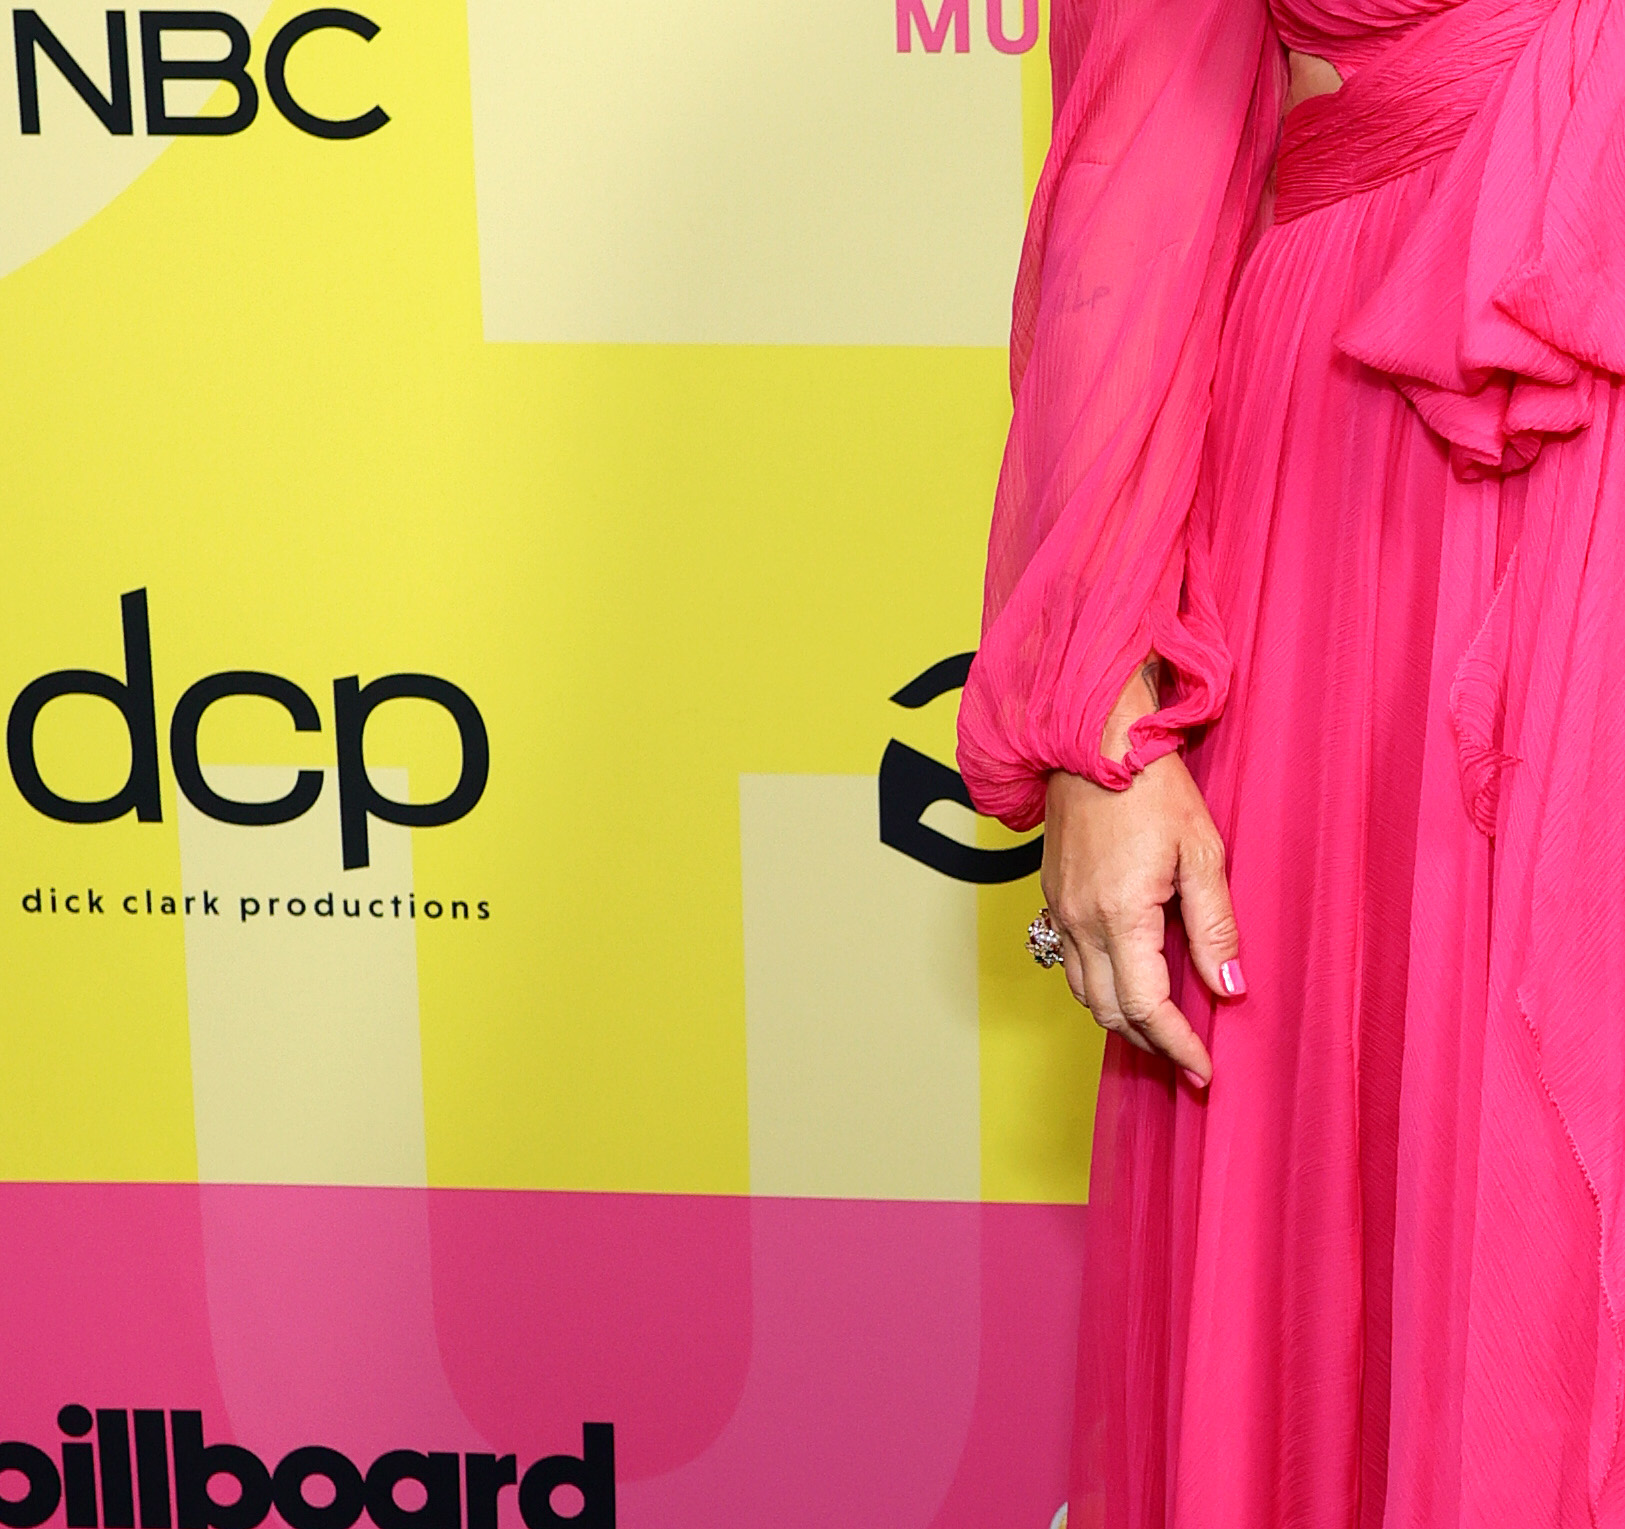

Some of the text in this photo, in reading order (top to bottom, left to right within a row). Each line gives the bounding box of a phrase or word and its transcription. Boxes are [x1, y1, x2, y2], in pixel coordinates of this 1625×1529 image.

[12, 7, 392, 140] NBC
[6, 587, 490, 872] dcp
[22, 888, 491, 923] dick clark productions
